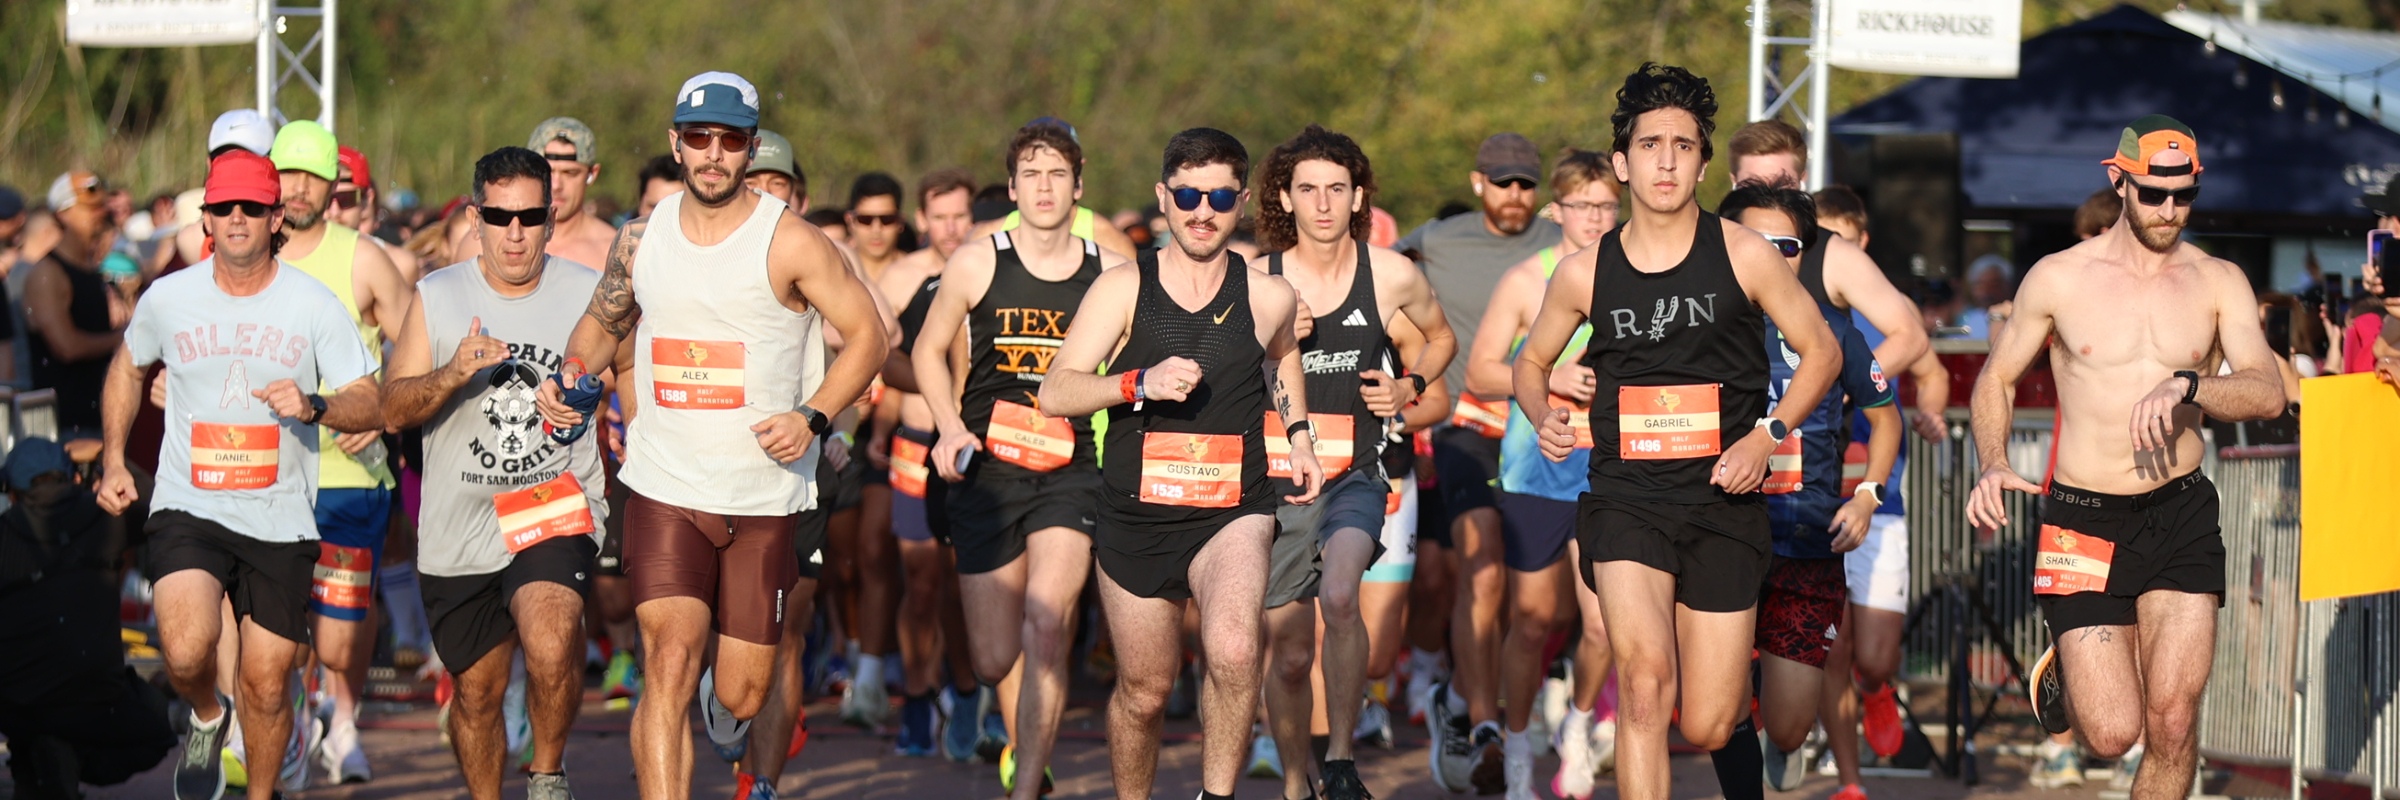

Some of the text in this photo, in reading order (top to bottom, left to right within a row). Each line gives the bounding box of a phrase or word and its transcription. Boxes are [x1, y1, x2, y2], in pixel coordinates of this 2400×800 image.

[1858, 11, 1994, 36] RICKHOUSE
[995, 307, 1072, 338] TEX
[174, 323, 309, 368] OILERS
[682, 371, 709, 380] ALEX
[661, 388, 687, 403] 1588
[1644, 418, 1693, 428] GABRIEL
[1014, 432, 1046, 446] CALEB
[1629, 439, 1662, 453] 1496
[215, 453, 252, 462] DANIEL
[468, 437, 497, 469] NO
[1167, 464, 1220, 477] GUSTAVO
[1271, 458, 1293, 471] 134
[197, 470, 225, 484] 1587
[461, 469, 559, 486] FORT SAM HOUSTON
[1151, 483, 1184, 499] 1525
[514, 526, 542, 546] 1601
[2045, 556, 2079, 568] SHANE
[324, 570, 354, 582] JAMES
